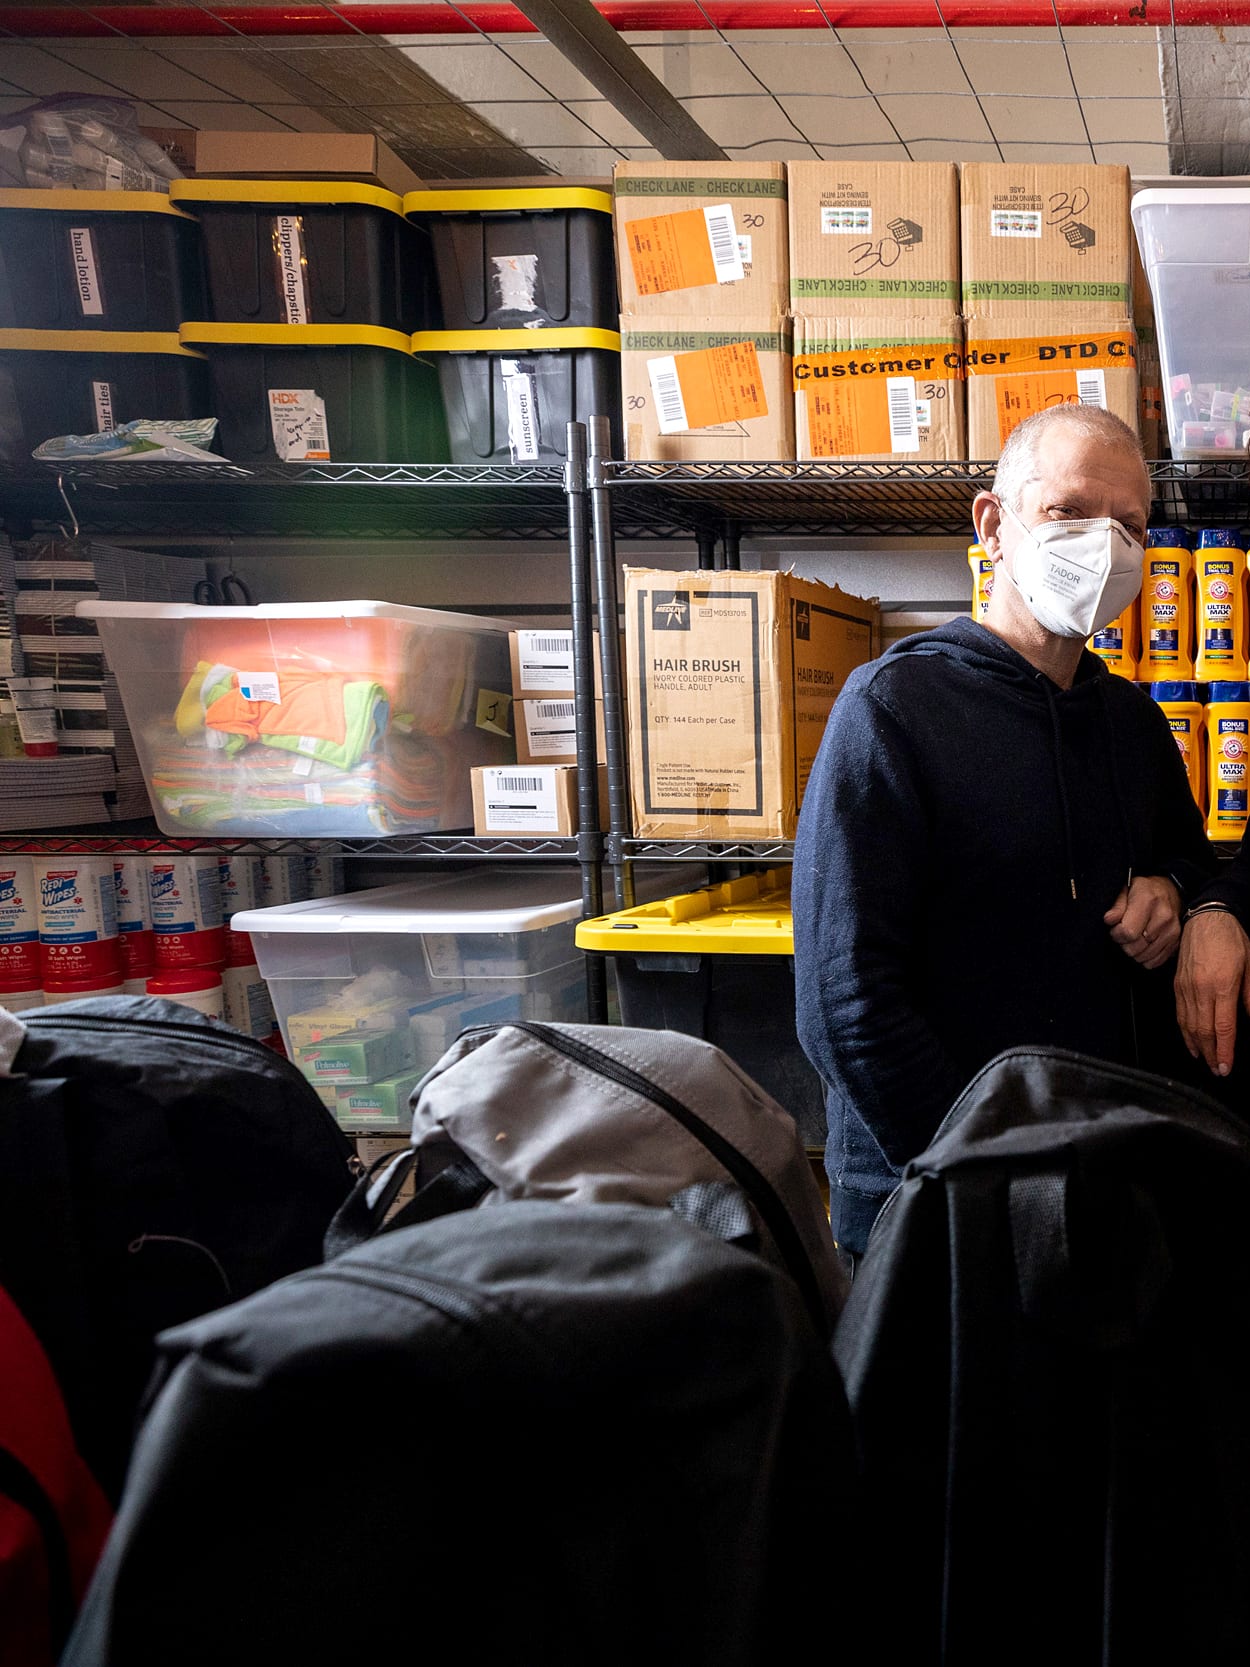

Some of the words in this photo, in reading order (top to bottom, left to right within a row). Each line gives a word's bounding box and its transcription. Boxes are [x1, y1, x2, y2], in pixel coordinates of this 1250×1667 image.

[626, 180, 663, 192] CHECK
[666, 181, 695, 193] LANE
[706, 182, 744, 194] CHECK
[746, 182, 776, 194] LANE
[1046, 186, 1090, 225] 30
[743, 214, 765, 228] 30
[73, 232, 87, 262] hand
[848, 237, 900, 275] 30
[78, 266, 91, 301] lotion
[798, 279, 827, 290] LANE
[830, 280, 867, 291] CHECK
[879, 281, 907, 292] LANE
[912, 281, 947, 292] CHECK
[972, 283, 1000, 294] LANE
[1002, 284, 1040, 294] CHECK
[1052, 284, 1079, 296] LANE
[1084, 285, 1120, 296] CHECK
[627, 336, 664, 347] CHECK
[667, 336, 695, 347] LANE
[708, 337, 744, 347] CHEC
[794, 358, 935, 379] Customer
[1039, 342, 1098, 360] DTD
[99, 385, 109, 406] ties
[272, 392, 299, 404] HDX
[923, 384, 946, 399] 30
[627, 396, 646, 410] 30
[100, 409, 112, 432] hair
[520, 394, 533, 453] sunscreen
[1050, 563, 1080, 584] TADOR
[653, 659, 688, 671] HAIR
[692, 660, 740, 672] BRUSH
[798, 667, 812, 683] HAIR
[814, 669, 834, 684] BRUSH
[41, 879, 63, 892] REDI
[44, 887, 75, 906] WIPES
[316, 1061, 350, 1069] Palmolive
